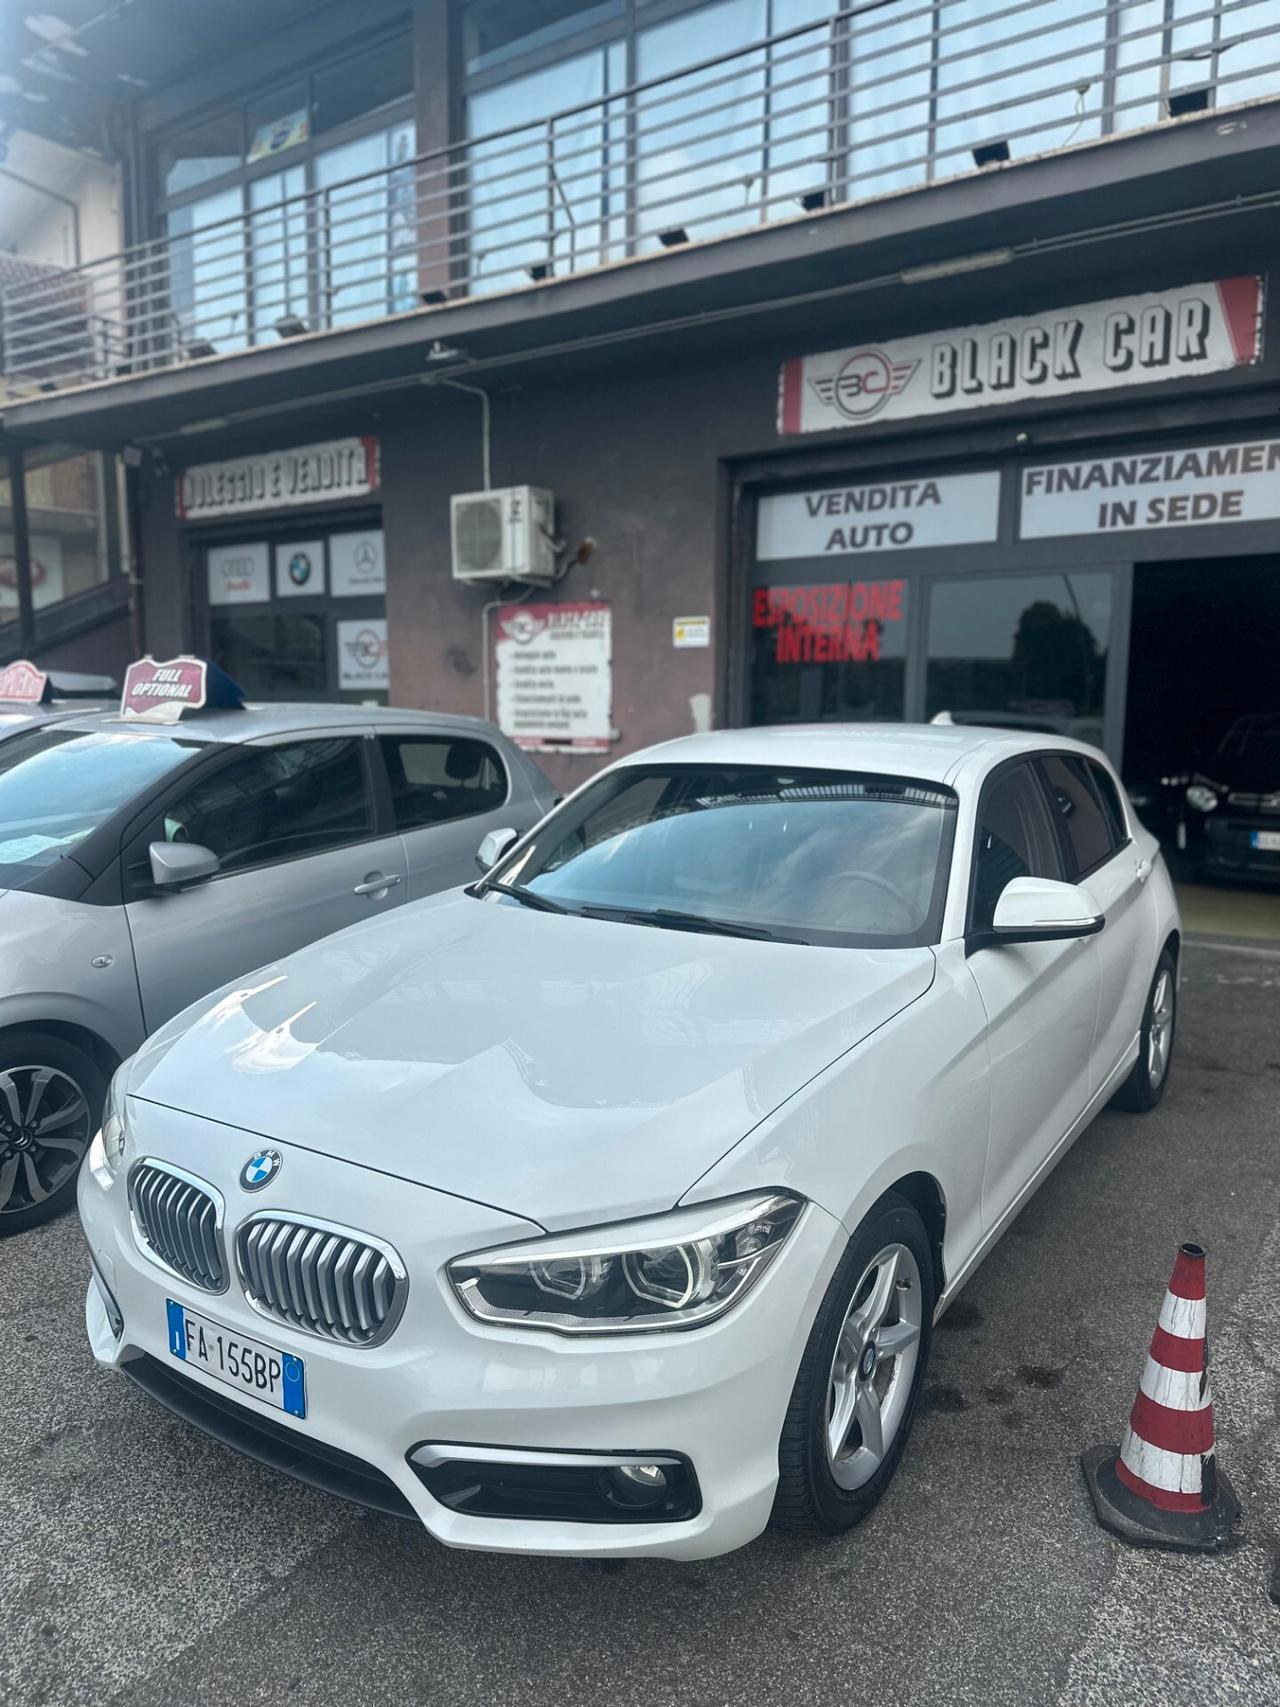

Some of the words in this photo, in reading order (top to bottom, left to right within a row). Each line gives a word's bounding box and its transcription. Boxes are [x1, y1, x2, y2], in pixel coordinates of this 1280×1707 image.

[929, 318, 1083, 399] BLACK
[1103, 298, 1211, 371] CAR
[287, 447, 369, 495] VENDITA
[804, 481, 942, 518] VENDITA
[1098, 500, 1137, 530] IN
[1146, 490, 1245, 525] SEDE
[824, 520, 914, 551] AUTO
[752, 578, 906, 629] ESPOSIZIONE
[775, 617, 881, 663] INTERNA
[131, 682, 193, 698] OPTIONAL
[152, 669, 183, 682] FULL
[184, 1317, 209, 1362] FA
[216, 1335, 281, 1393] 155BP
